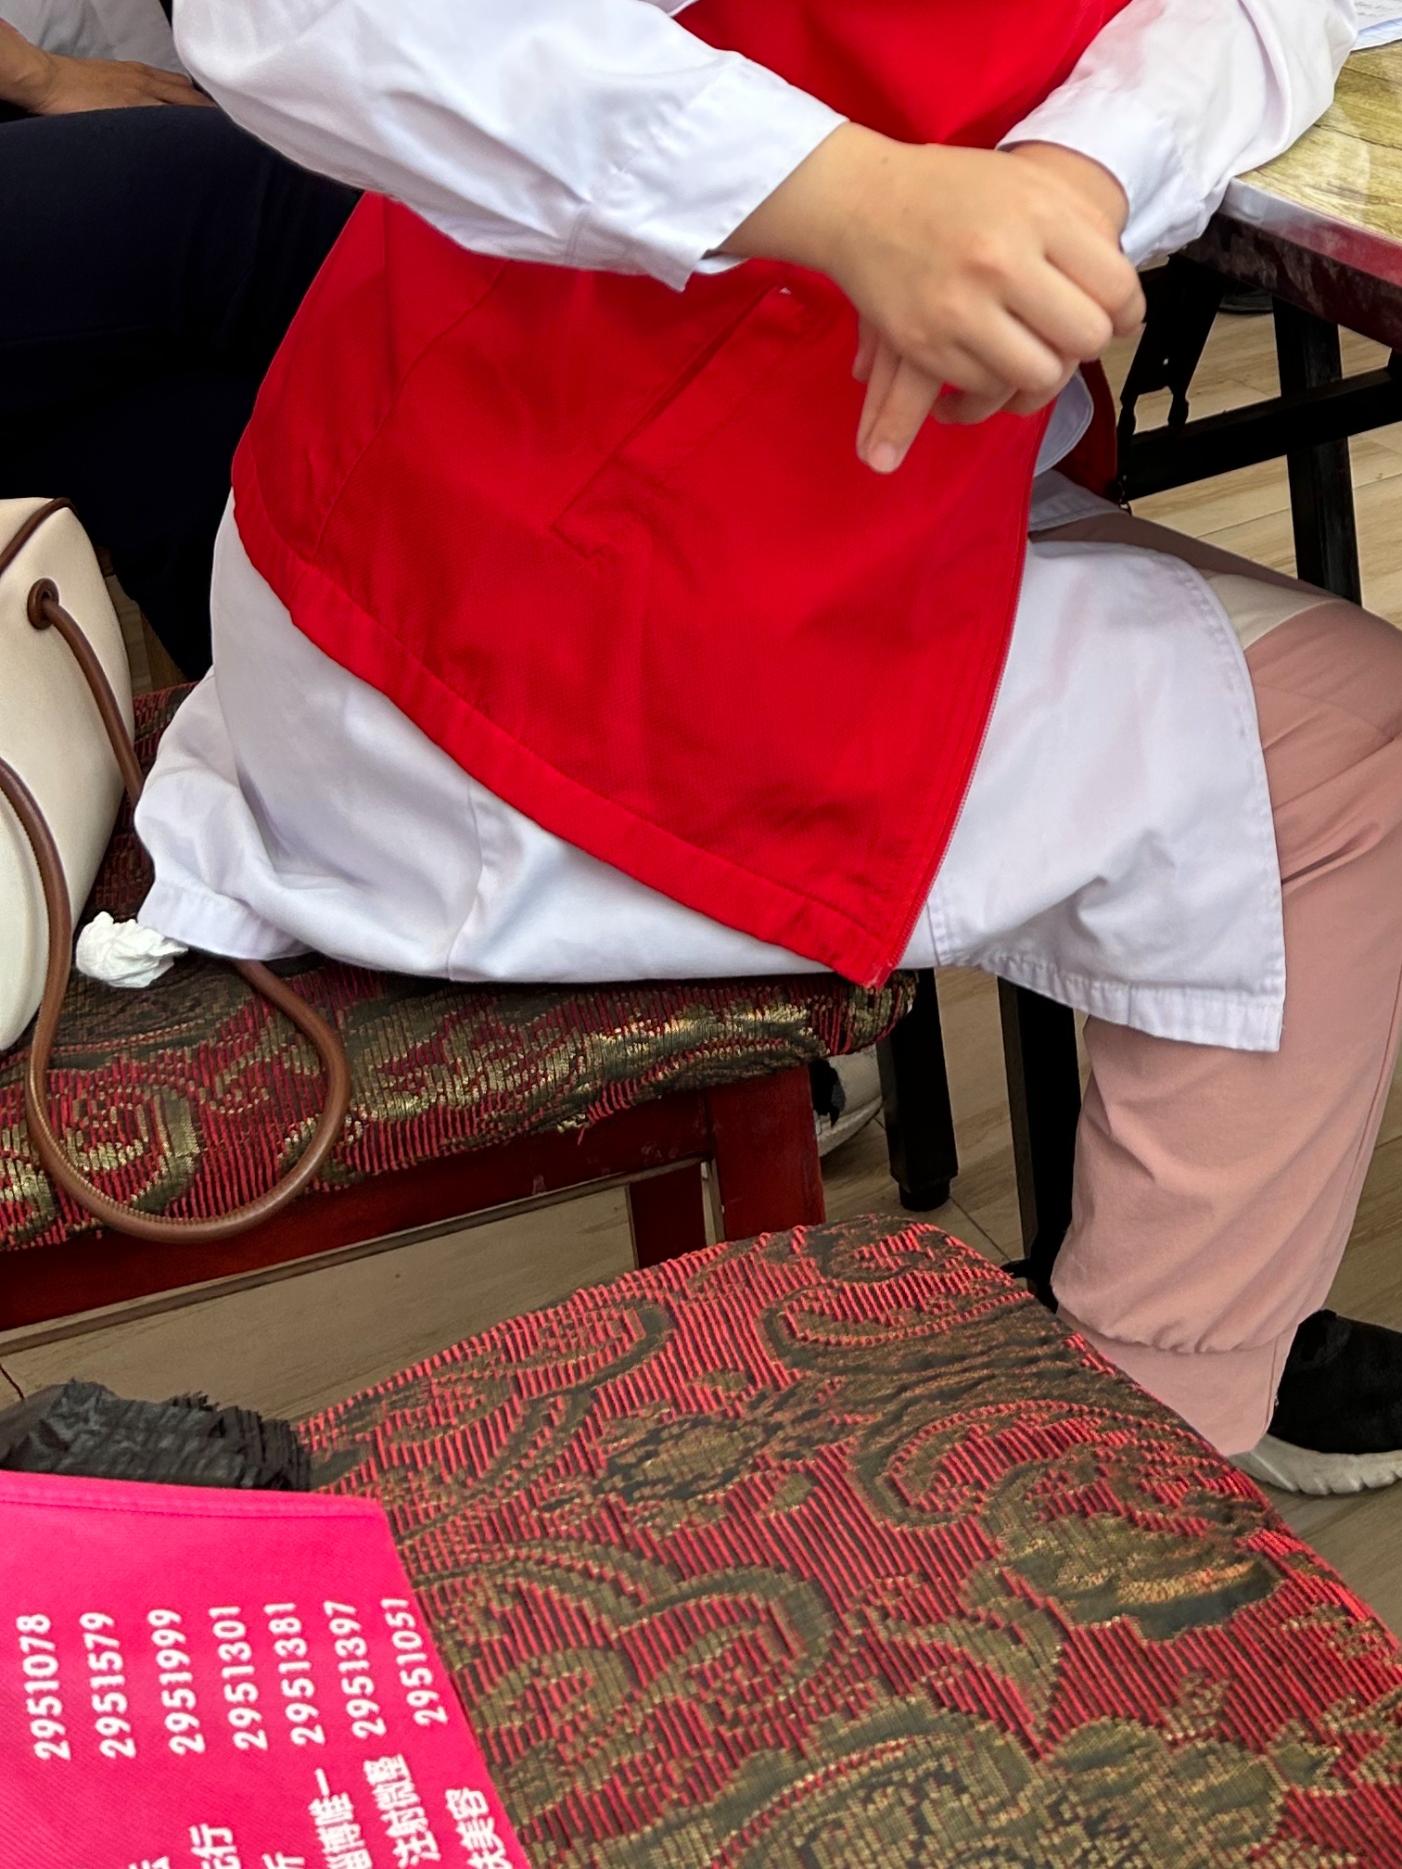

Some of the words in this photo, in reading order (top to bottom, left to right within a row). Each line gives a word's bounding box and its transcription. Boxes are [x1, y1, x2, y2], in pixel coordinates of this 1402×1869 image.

[16, 1614, 70, 1760] 2951078
[80, 1612, 136, 1758] 2951579
[148, 1609, 205, 1755] 2951999
[208, 1606, 267, 1750] 2951301
[264, 1603, 325, 1746] 2951381
[324, 1600, 386, 1739] 2951397
[381, 1598, 448, 1726] 2951051
[363, 1754, 441, 1868] 注射微整
